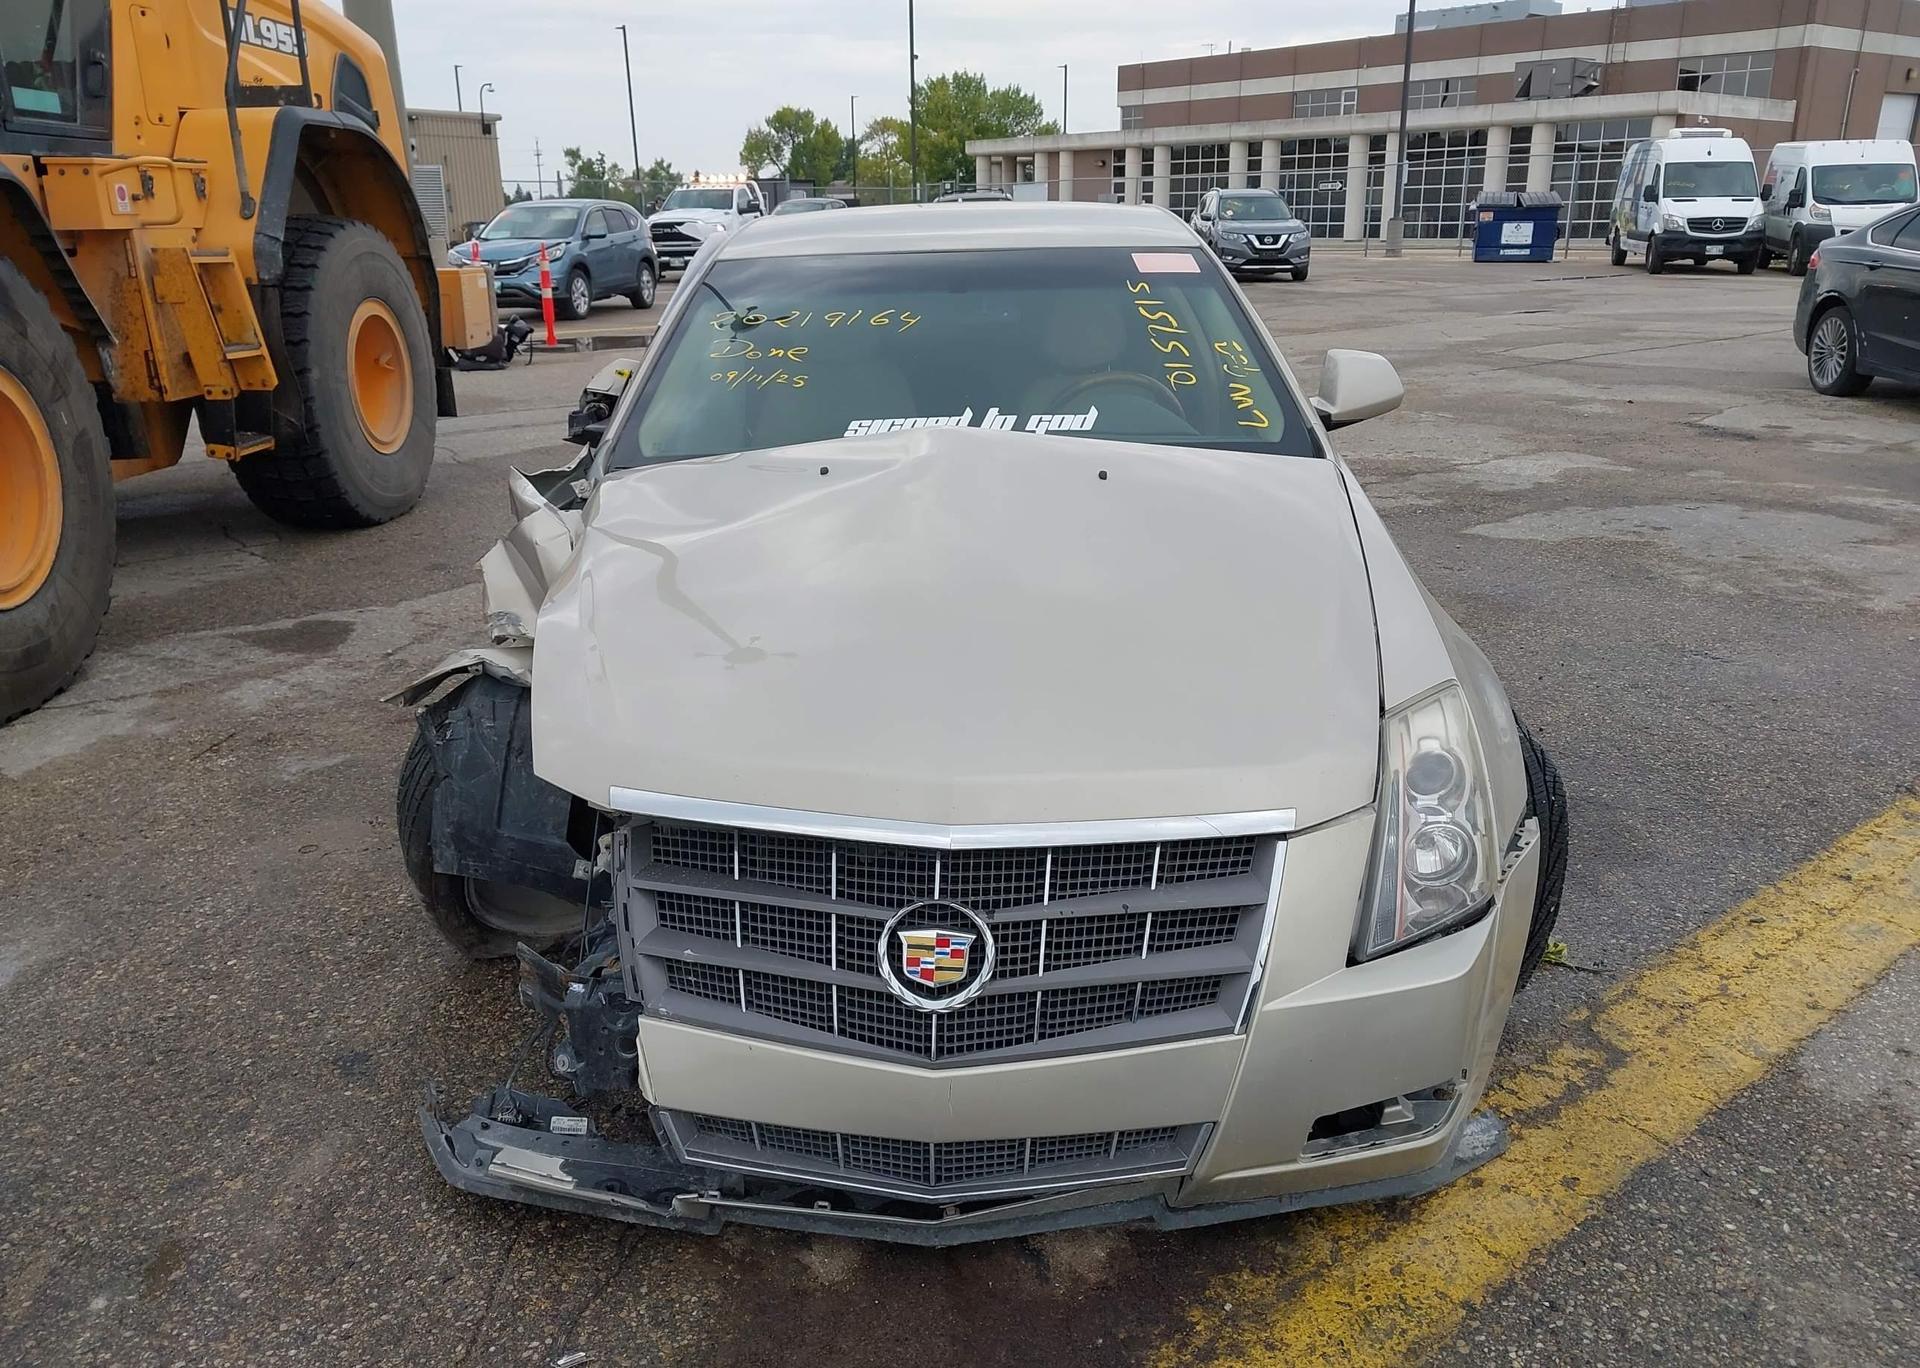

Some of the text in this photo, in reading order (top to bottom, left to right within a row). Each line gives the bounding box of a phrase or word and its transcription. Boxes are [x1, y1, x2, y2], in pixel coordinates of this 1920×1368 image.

[710, 338, 809, 362] Done
[710, 366, 809, 391] 09/11/25
[980, 407, 1018, 431] to
[1025, 405, 1099, 434] god
